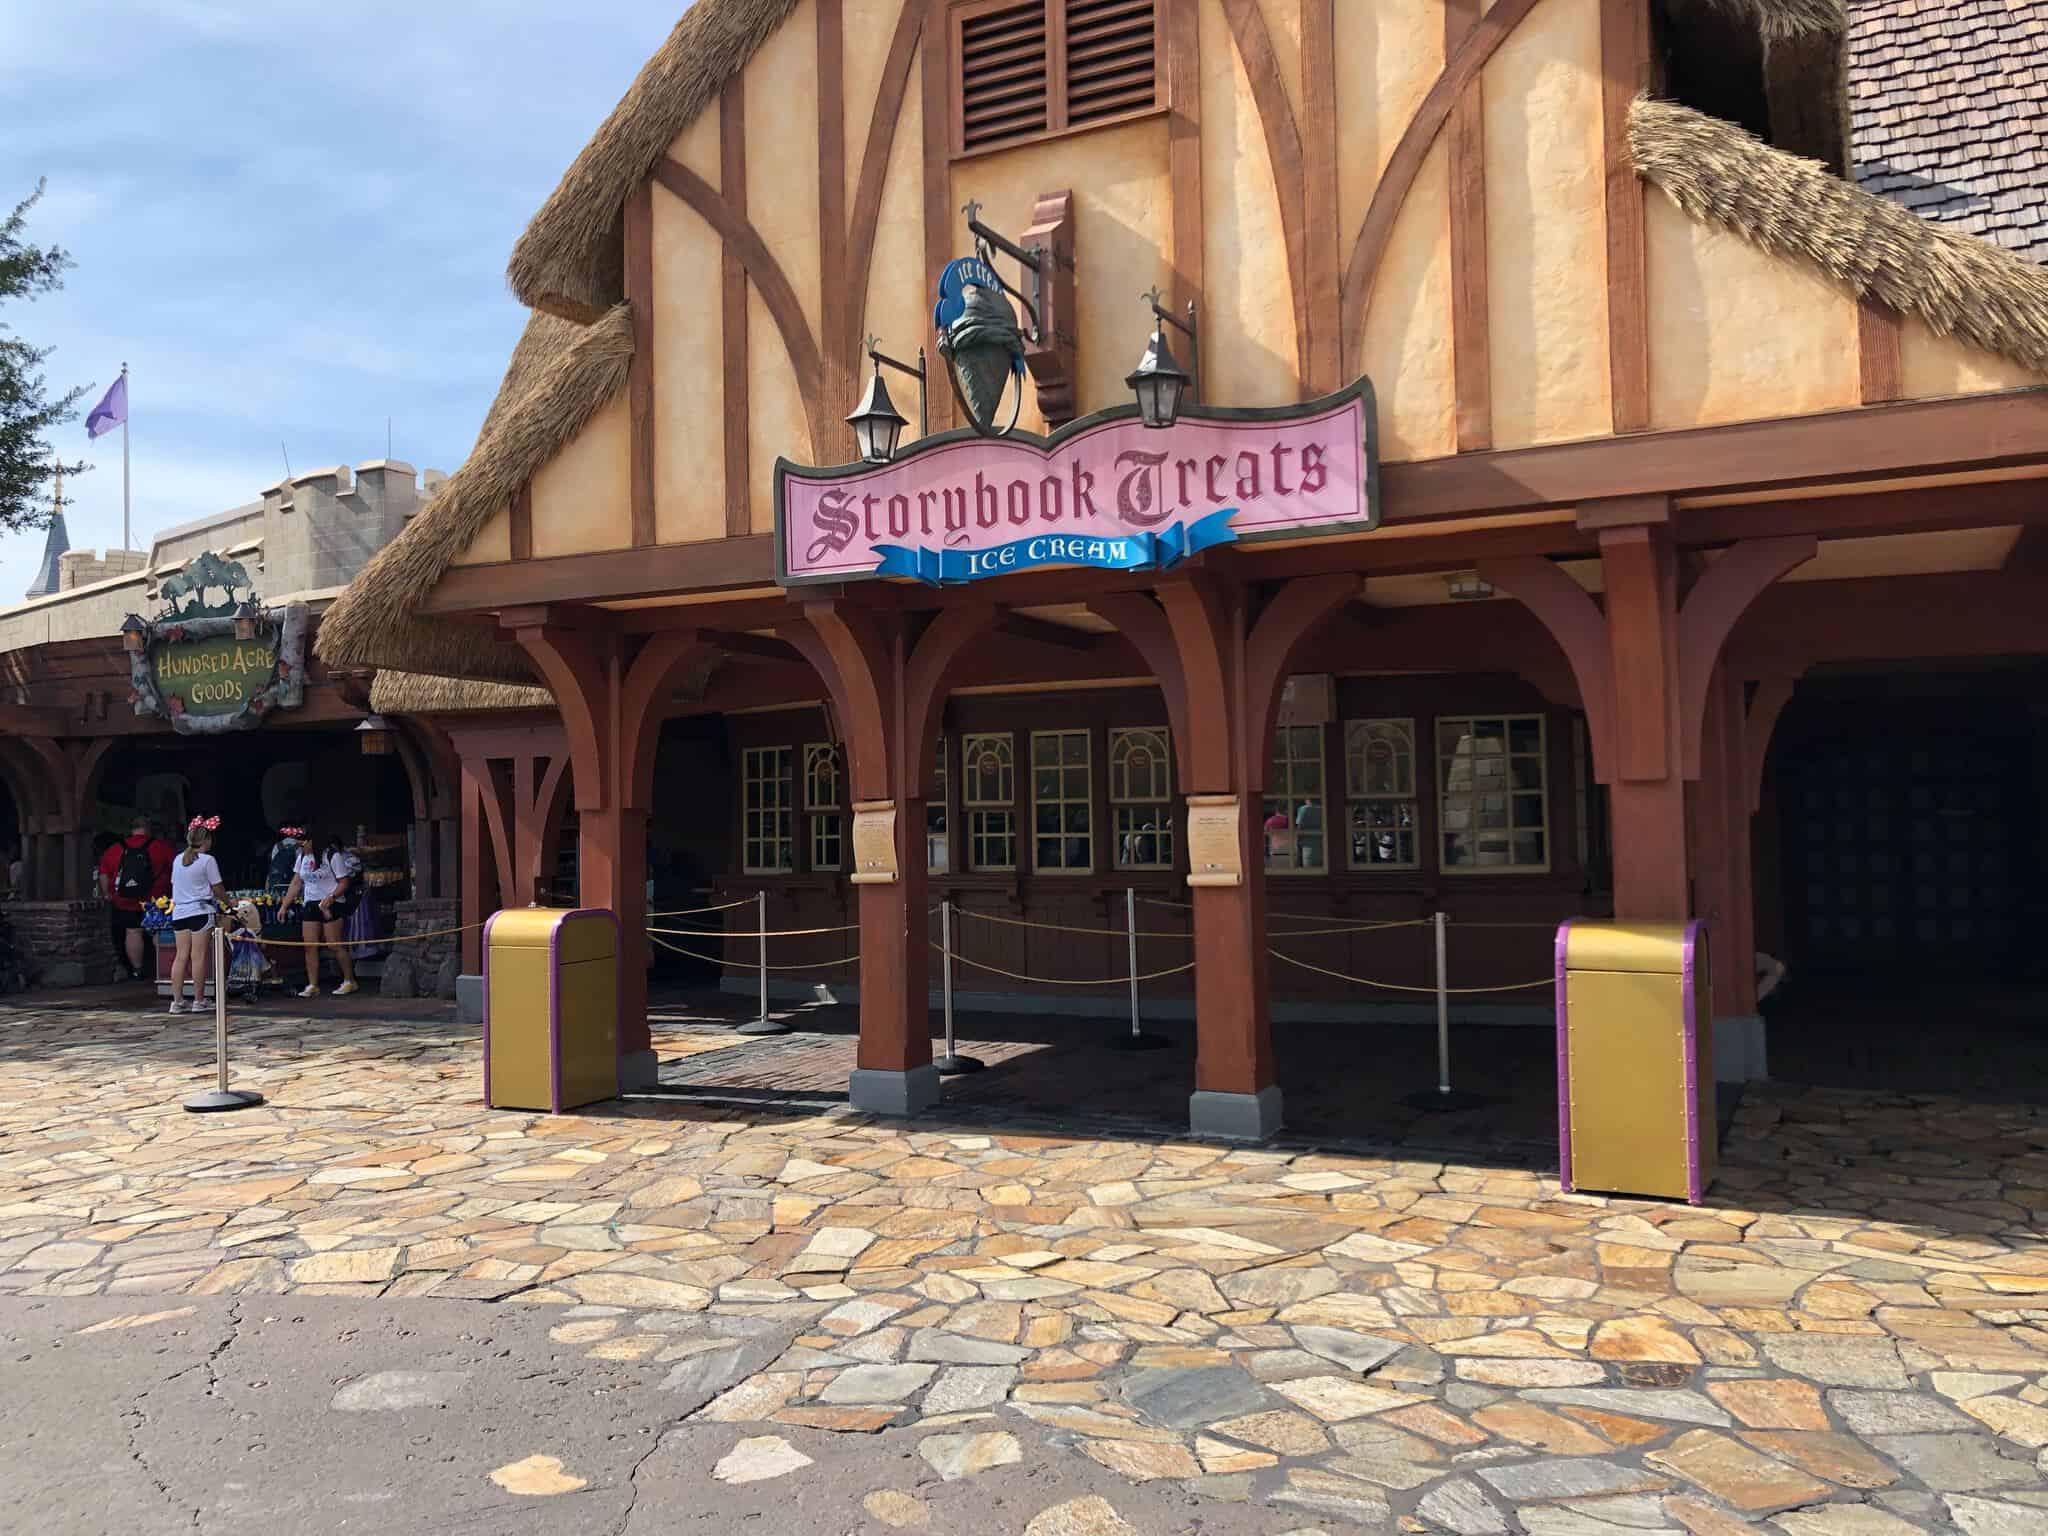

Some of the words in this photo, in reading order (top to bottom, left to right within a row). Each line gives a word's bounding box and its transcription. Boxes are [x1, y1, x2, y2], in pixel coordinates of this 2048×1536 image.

[806, 460, 1096, 564] Storybook
[1114, 440, 1330, 526] Treats
[967, 546, 1016, 575] ICE
[1027, 537, 1128, 564] CREAM
[158, 652, 229, 678] HUNDRED
[232, 646, 275, 675] ACRE
[191, 680, 242, 703] GOODS
